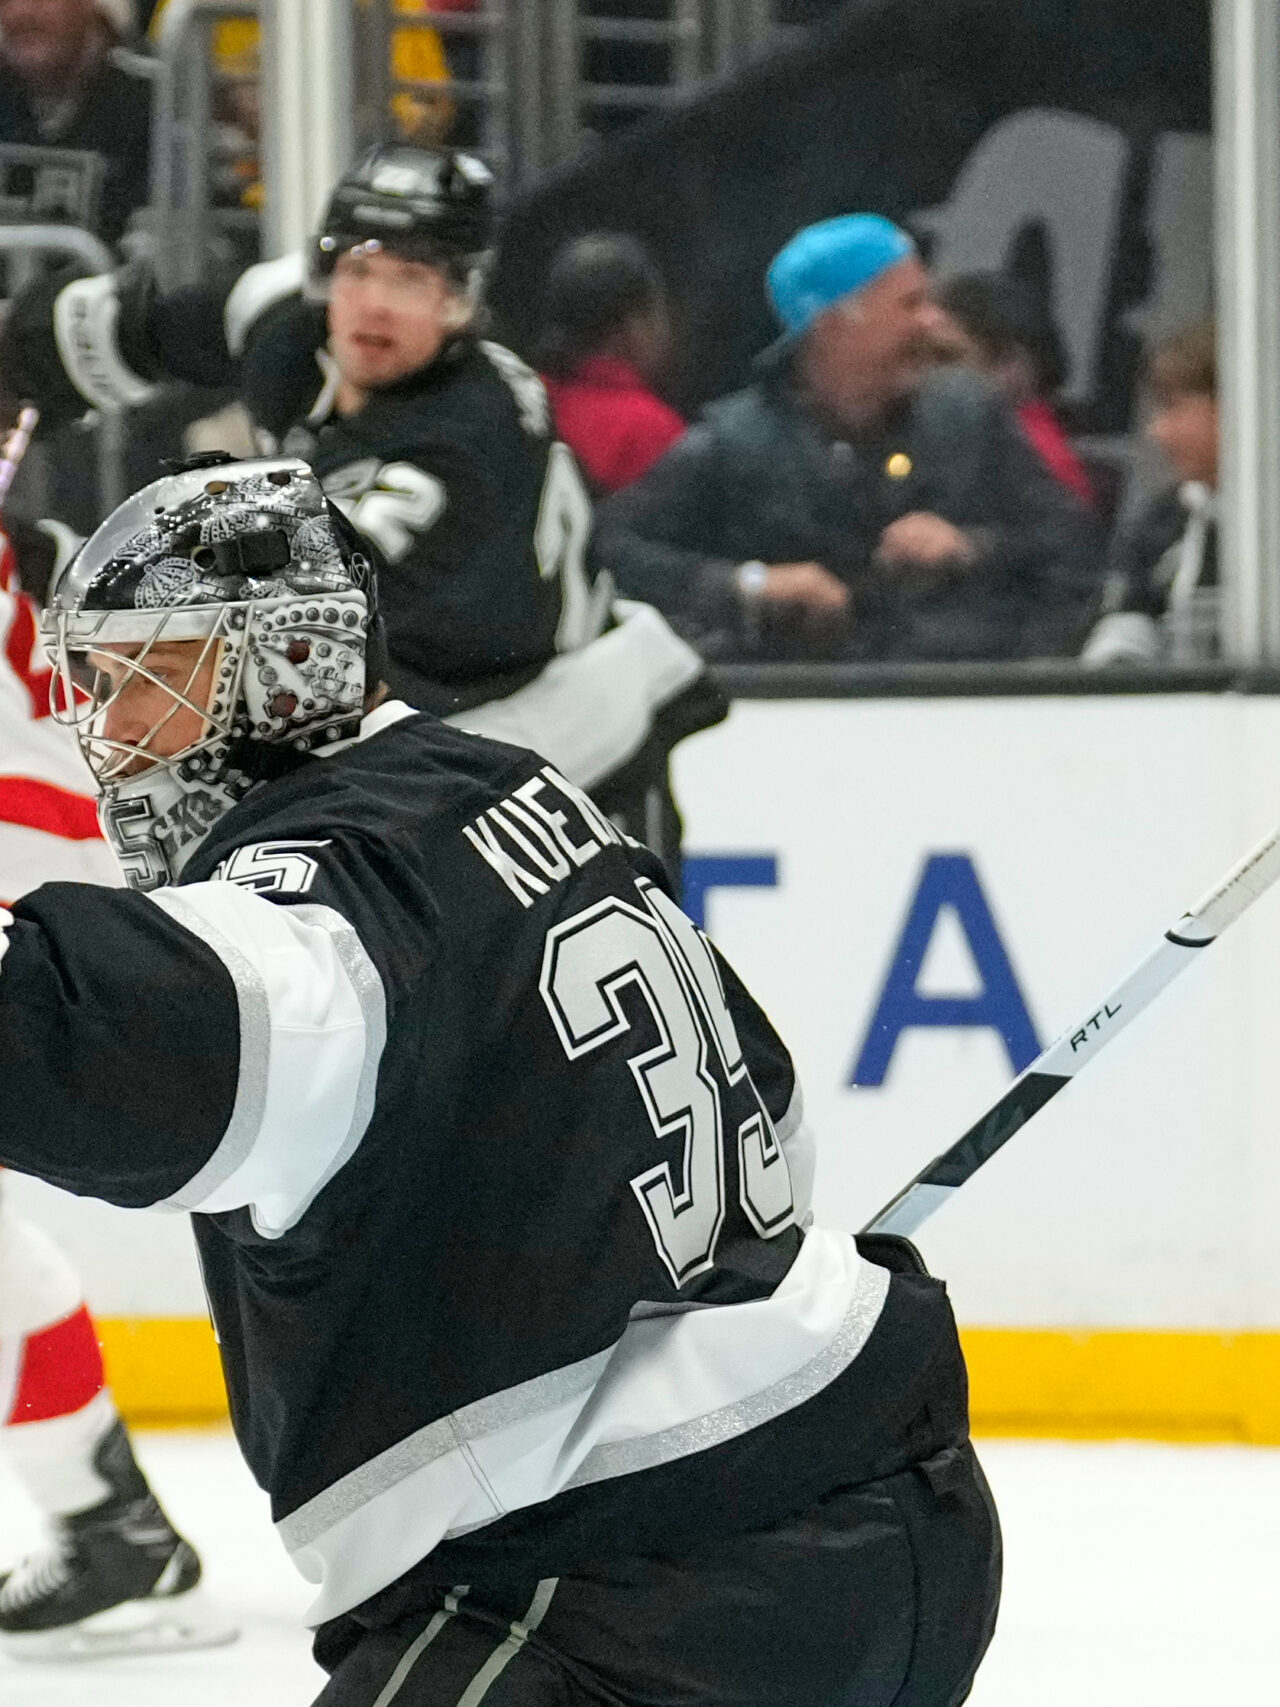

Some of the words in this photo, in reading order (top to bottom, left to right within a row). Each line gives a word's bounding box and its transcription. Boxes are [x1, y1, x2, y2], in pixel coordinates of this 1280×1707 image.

[209, 839, 333, 893] 5
[1069, 1002, 1122, 1053] RTL
[539, 876, 795, 1290] 35
